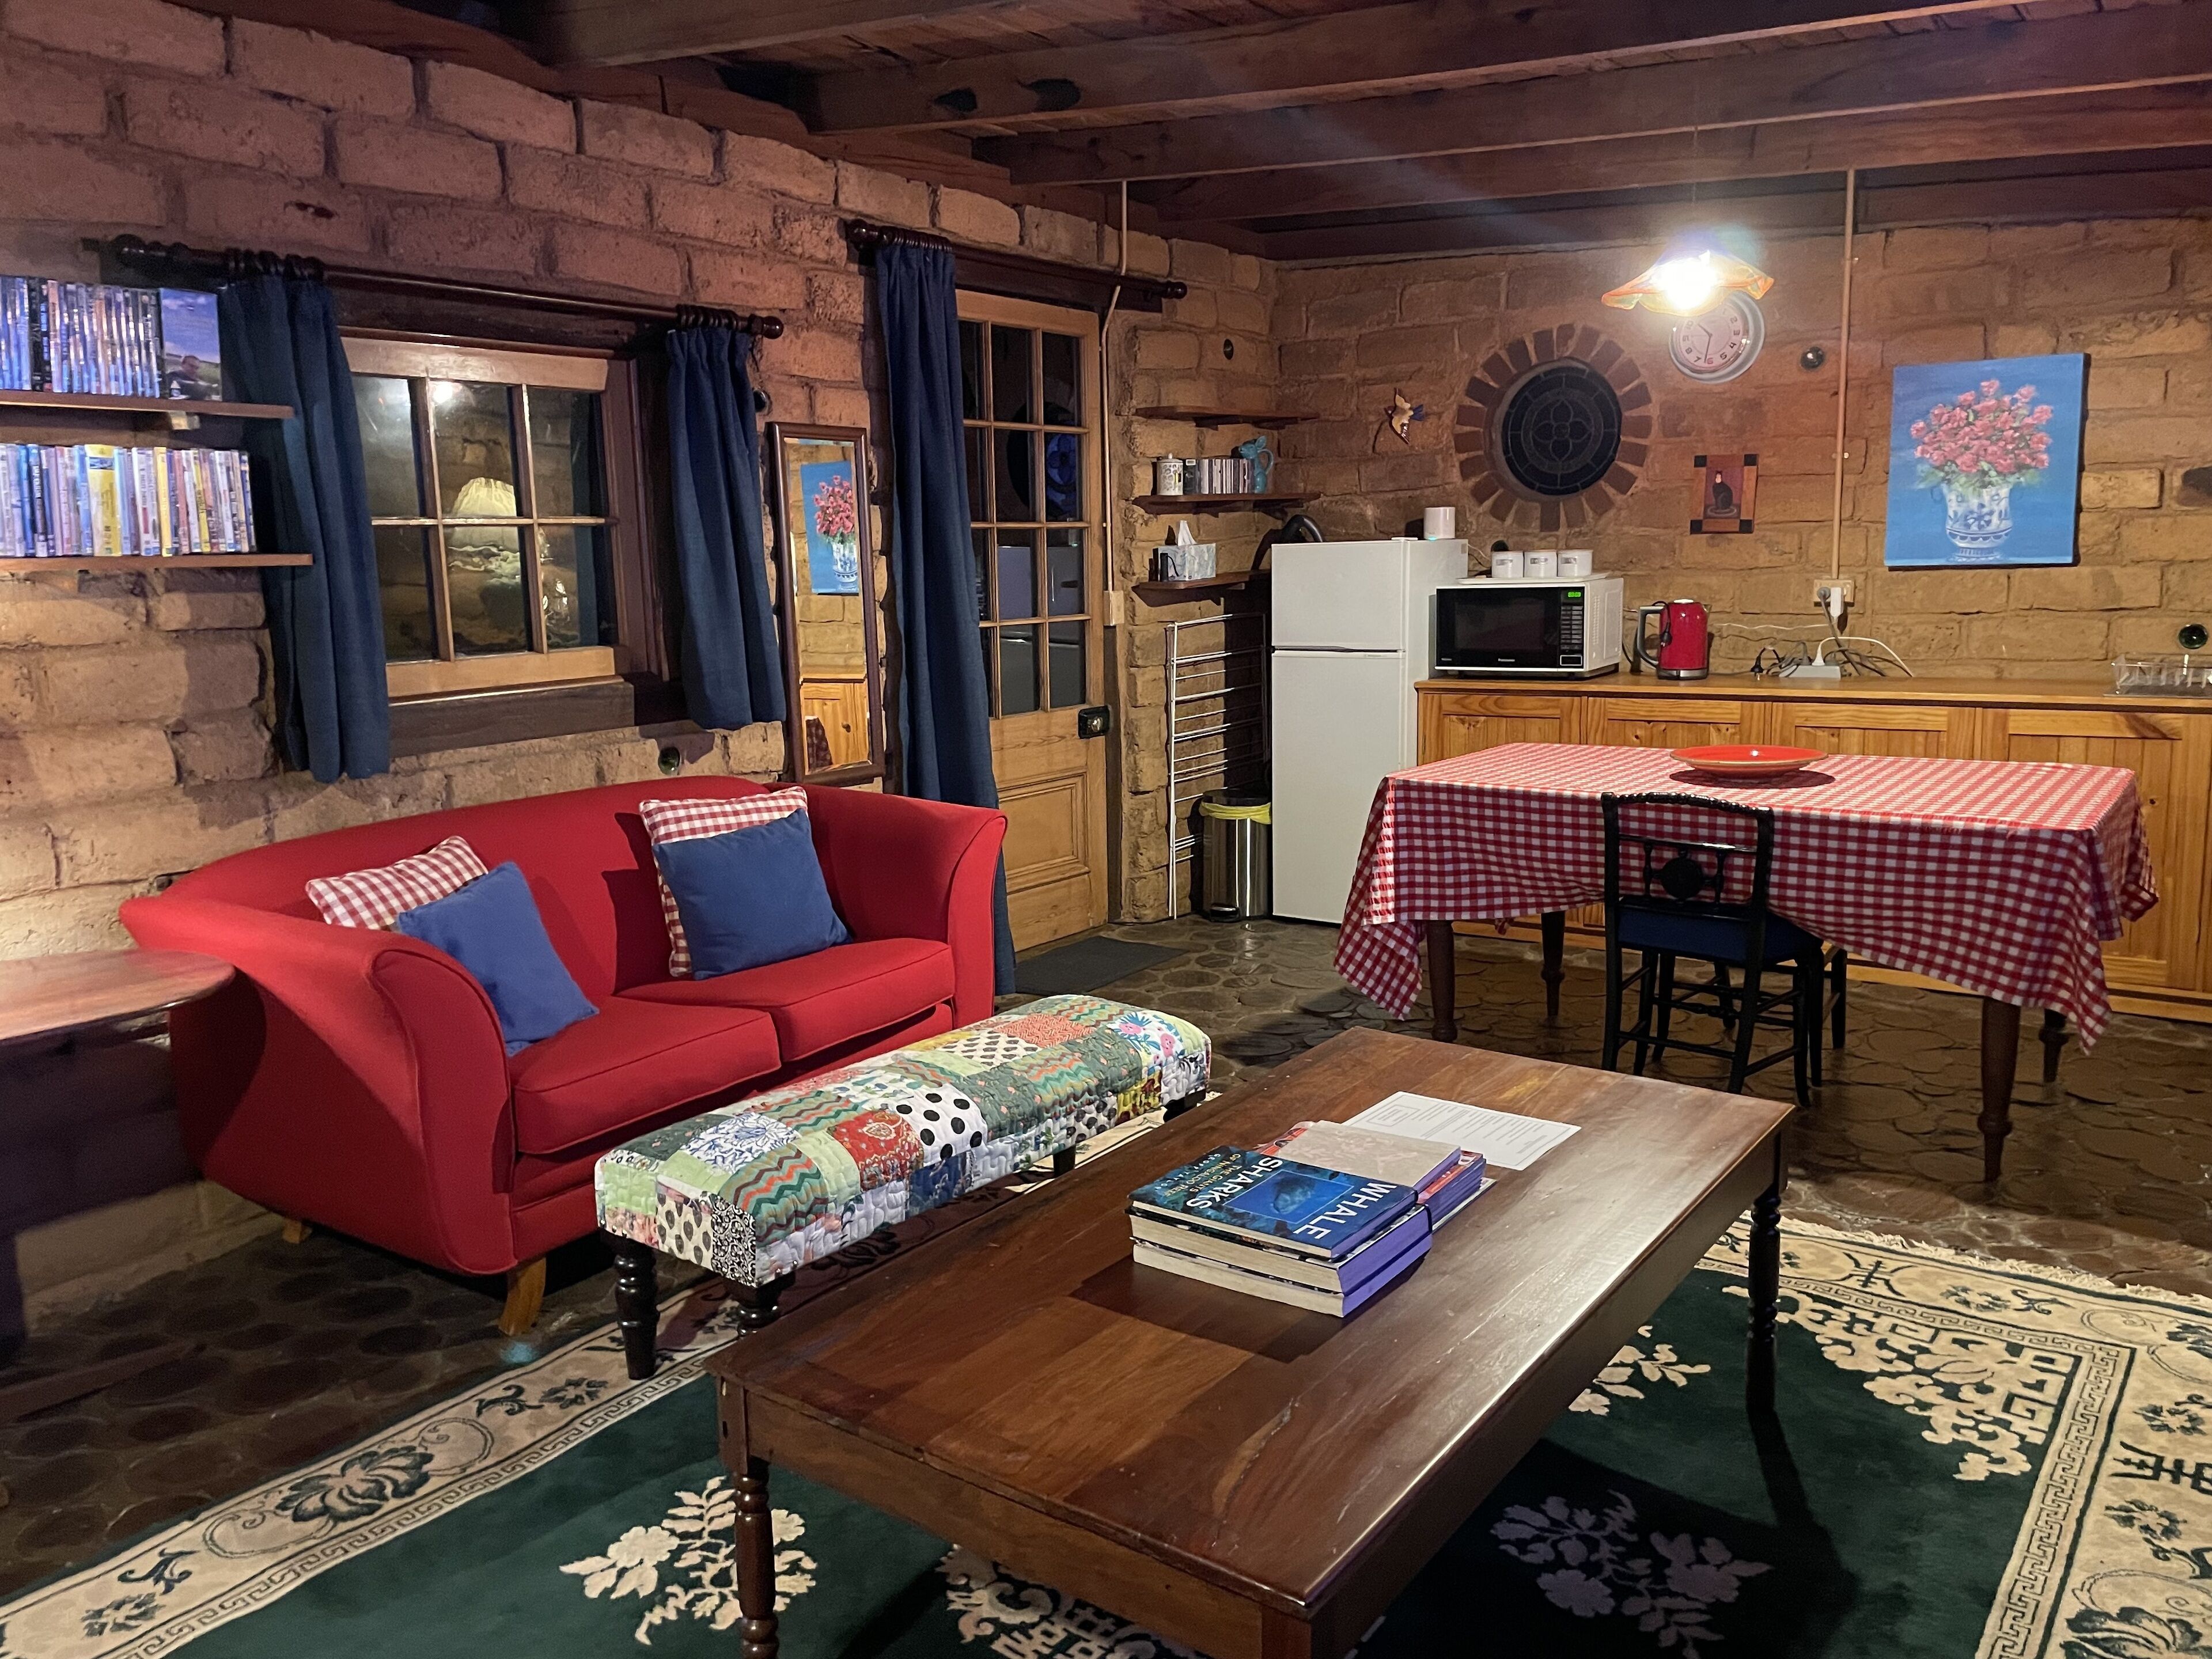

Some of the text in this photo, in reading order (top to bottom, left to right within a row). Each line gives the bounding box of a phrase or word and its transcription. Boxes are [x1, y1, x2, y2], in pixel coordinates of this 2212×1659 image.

[1685, 320, 1695, 329] 10
[1730, 316, 1738, 324] 2
[1720, 352, 1728, 360] 5
[1186, 1160, 1231, 1184] NINGALOO
[1186, 1157, 1283, 1209] SHARKS
[1190, 1165, 1243, 1192] THE GIANTS
[1293, 1183, 1397, 1239] WHALE
